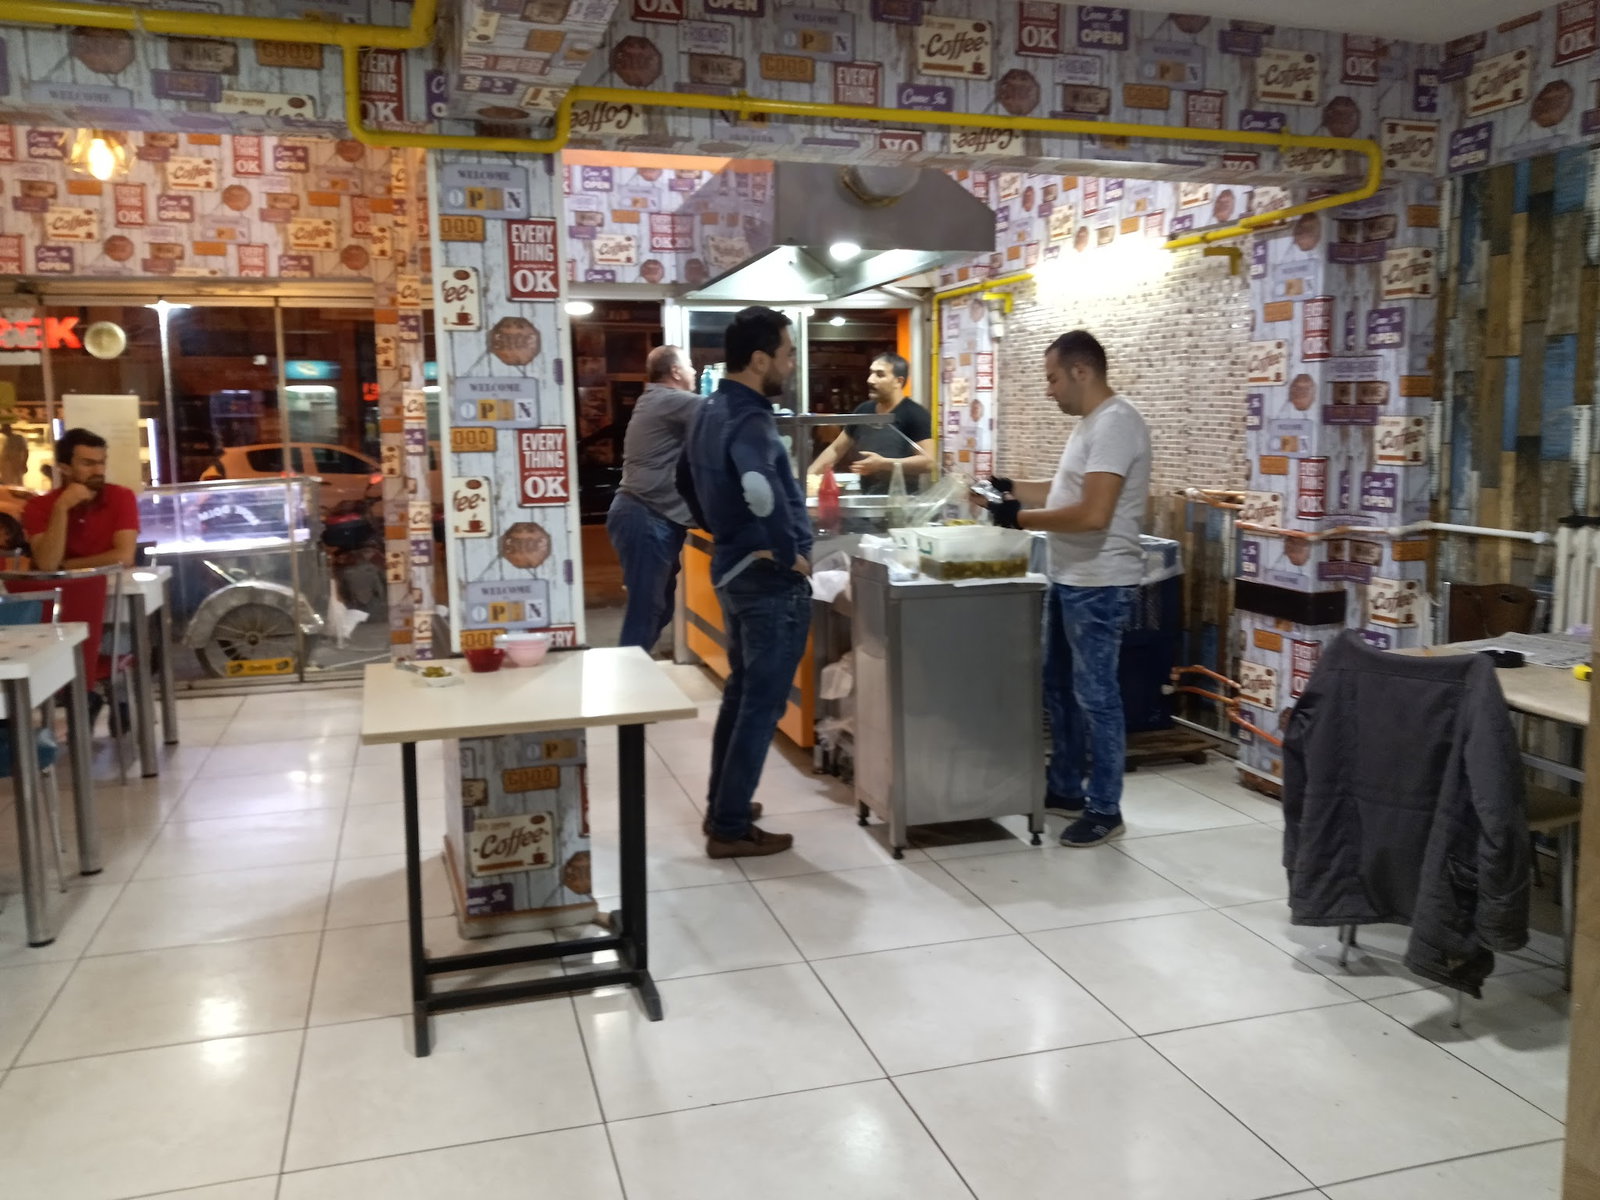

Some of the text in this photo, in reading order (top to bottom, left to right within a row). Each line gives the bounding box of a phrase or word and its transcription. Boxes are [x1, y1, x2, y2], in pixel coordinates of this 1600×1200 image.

[925, 31, 985, 60] Coffee
[1021, 25, 1058, 50] OK
[1080, 30, 1123, 46] OPEN
[1263, 62, 1314, 89] Coffee
[458, 170, 510, 181] WELCOME
[511, 224, 555, 242] EVERY
[512, 242, 554, 261] THING
[513, 270, 558, 293] OK
[470, 383, 522, 393] WELCOME
[522, 433, 563, 450] EVERY
[523, 451, 565, 469] THING
[524, 477, 567, 498] OK
[481, 585, 532, 596] WELCOME
[480, 826, 545, 859] Coffee
